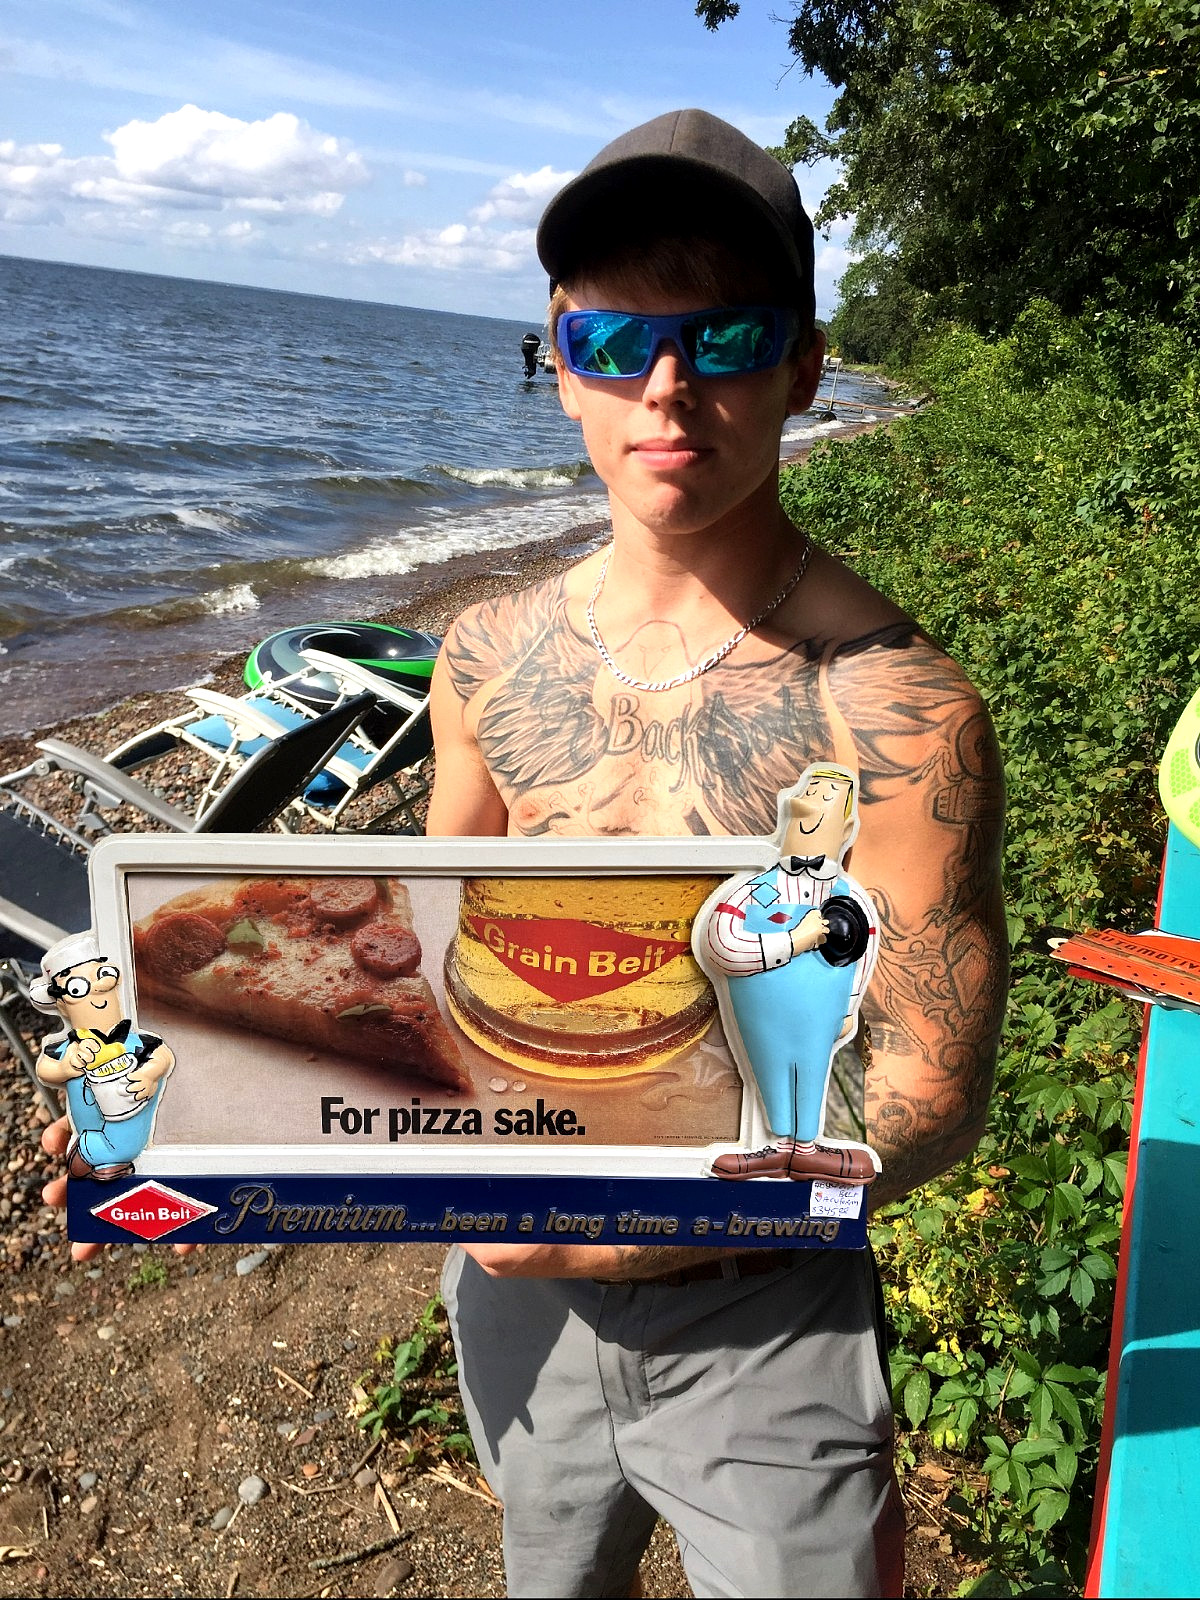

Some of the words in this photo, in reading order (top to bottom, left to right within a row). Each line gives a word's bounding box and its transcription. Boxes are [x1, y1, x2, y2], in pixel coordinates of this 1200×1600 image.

[483, 922, 577, 975] Grain
[588, 945, 665, 977] Belt
[1090, 930, 1200, 973] AUTOMOTIV
[321, 1097, 380, 1134] For
[389, 1098, 482, 1142] pizza
[493, 1098, 586, 1136] sake.
[110, 1207, 155, 1221] Grain
[158, 1206, 190, 1220] Belt
[440, 1206, 510, 1231] been
[517, 1211, 535, 1232] a
[543, 1206, 606, 1239] long
[616, 1209, 681, 1235] time
[692, 1210, 841, 1242] a-brewing
